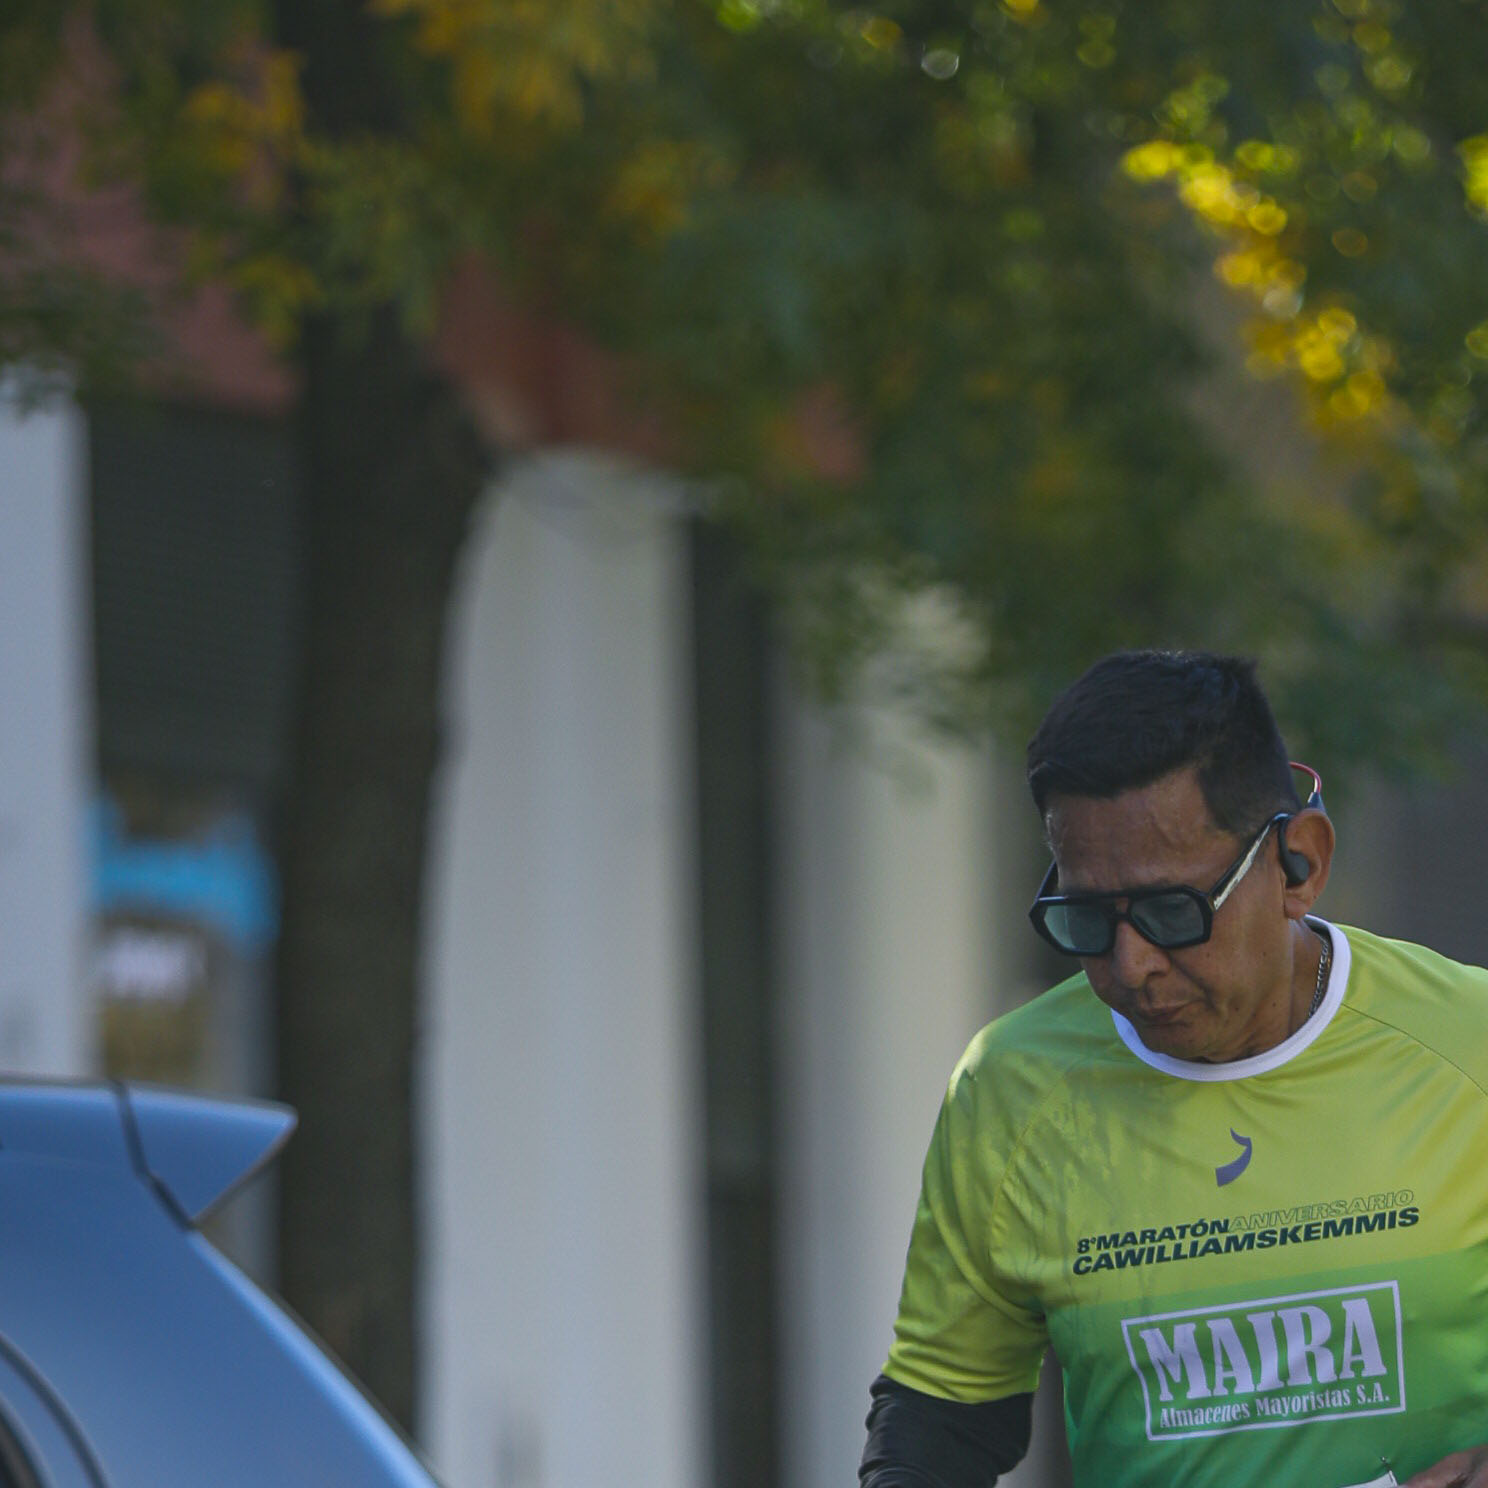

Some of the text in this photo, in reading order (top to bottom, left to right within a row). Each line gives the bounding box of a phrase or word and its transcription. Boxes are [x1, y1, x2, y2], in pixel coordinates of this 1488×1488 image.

[1072, 1206, 1420, 1275] CAWILLIAMSKEMMIS
[1139, 1298, 1387, 1401] MAIRA
[1160, 1381, 1390, 1429] Almacenes Mayoristas S.A.
